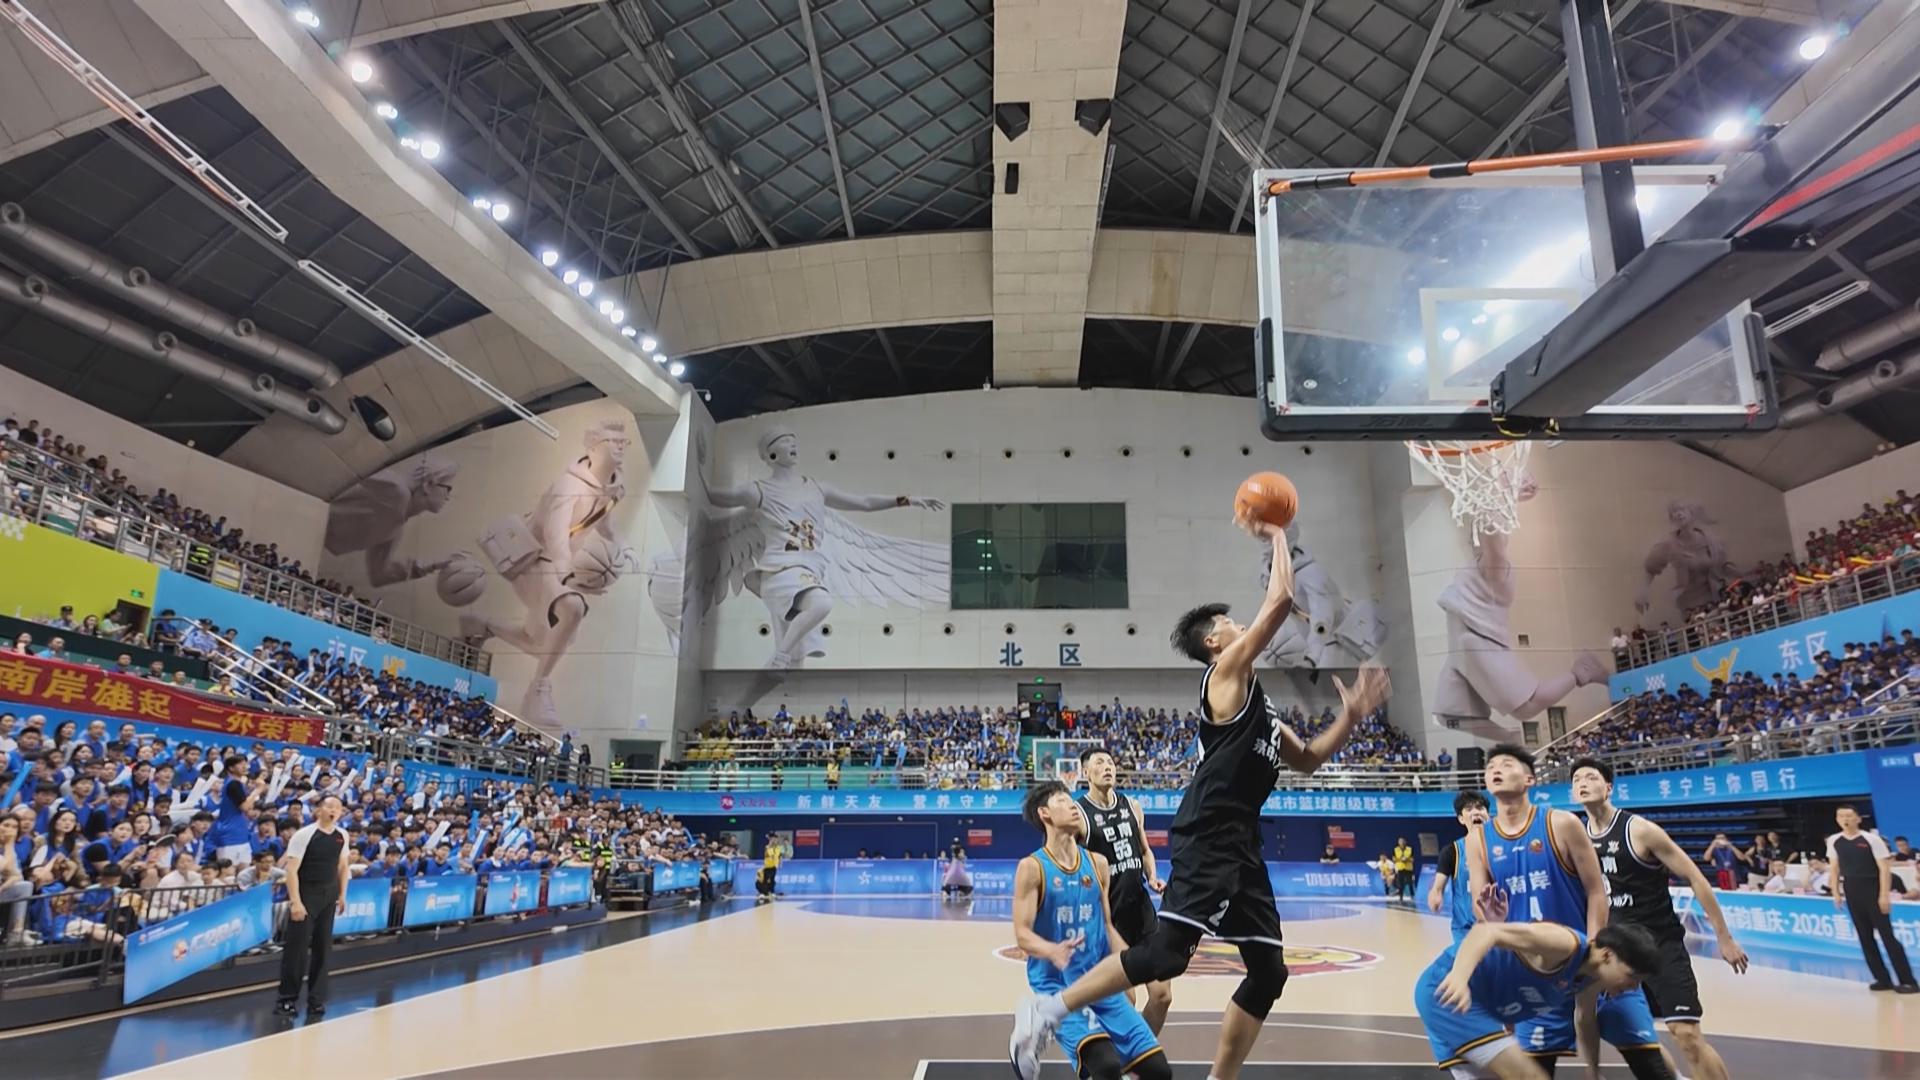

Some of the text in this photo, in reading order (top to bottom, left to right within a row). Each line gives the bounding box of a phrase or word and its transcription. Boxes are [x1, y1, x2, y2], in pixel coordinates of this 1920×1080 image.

[999, 641, 1082, 667] 北区
[1778, 631, 1828, 670] 东区
[0, 660, 313, 745] 南岸雄起 二外荣誉
[1659, 767, 1797, 797] 李宁与你同行
[797, 794, 999, 810] 新鲜天友 营养守护
[1129, 794, 1395, 812] 韵重庆 城市篮球超级联赛
[1102, 822, 1133, 842] 巴南
[1113, 838, 1133, 861] 55
[1292, 871, 1371, 888] 一切皆有可能
[1505, 870, 1551, 895] 南岸
[1056, 905, 1093, 924] 南岸
[1208, 899, 1230, 927] 2
